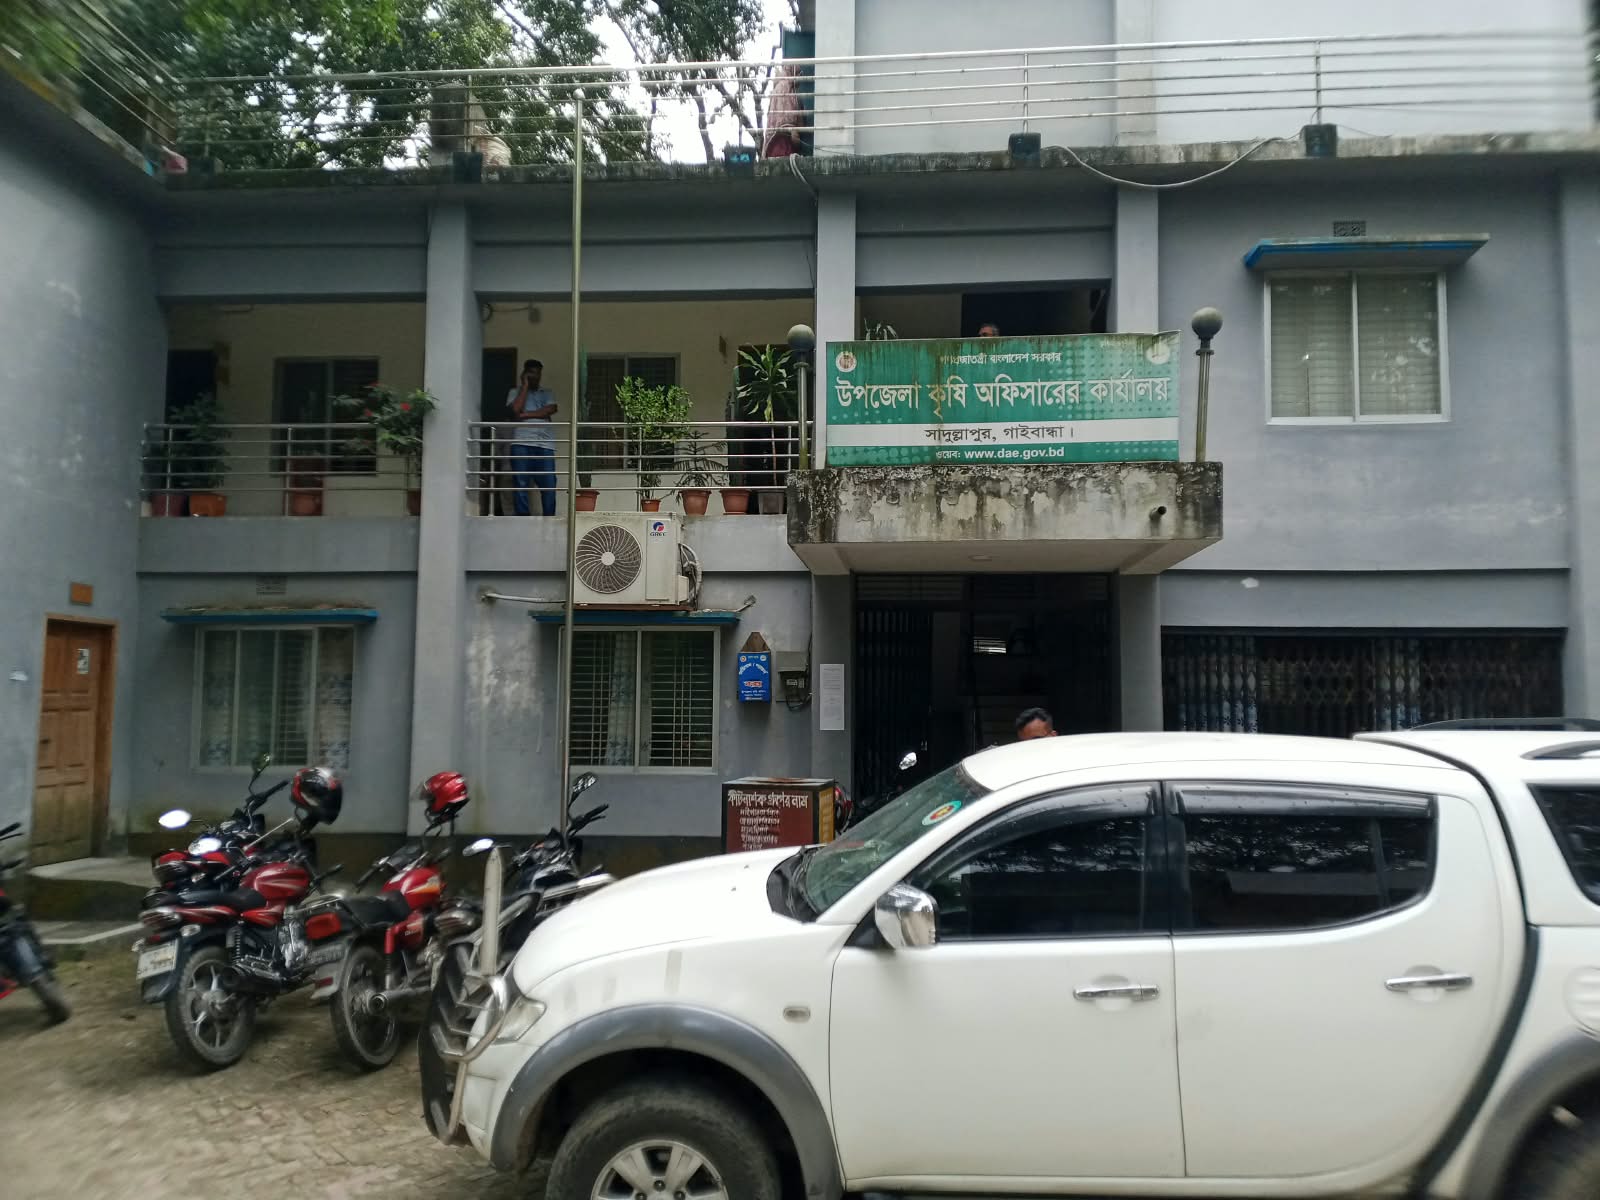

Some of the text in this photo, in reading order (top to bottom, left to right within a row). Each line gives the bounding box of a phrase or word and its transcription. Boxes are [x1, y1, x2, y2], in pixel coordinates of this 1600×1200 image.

[989, 352, 1030, 364] বাংলাদেশ
[834, 368, 1171, 421] উপজেলা কৃষি অফিসারের কার্যালয়
[924, 428, 997, 443] সাদুল্লাপুর,
[964, 446, 1065, 460] www.dae.gov.bd
[792, 795, 808, 809] নাম
